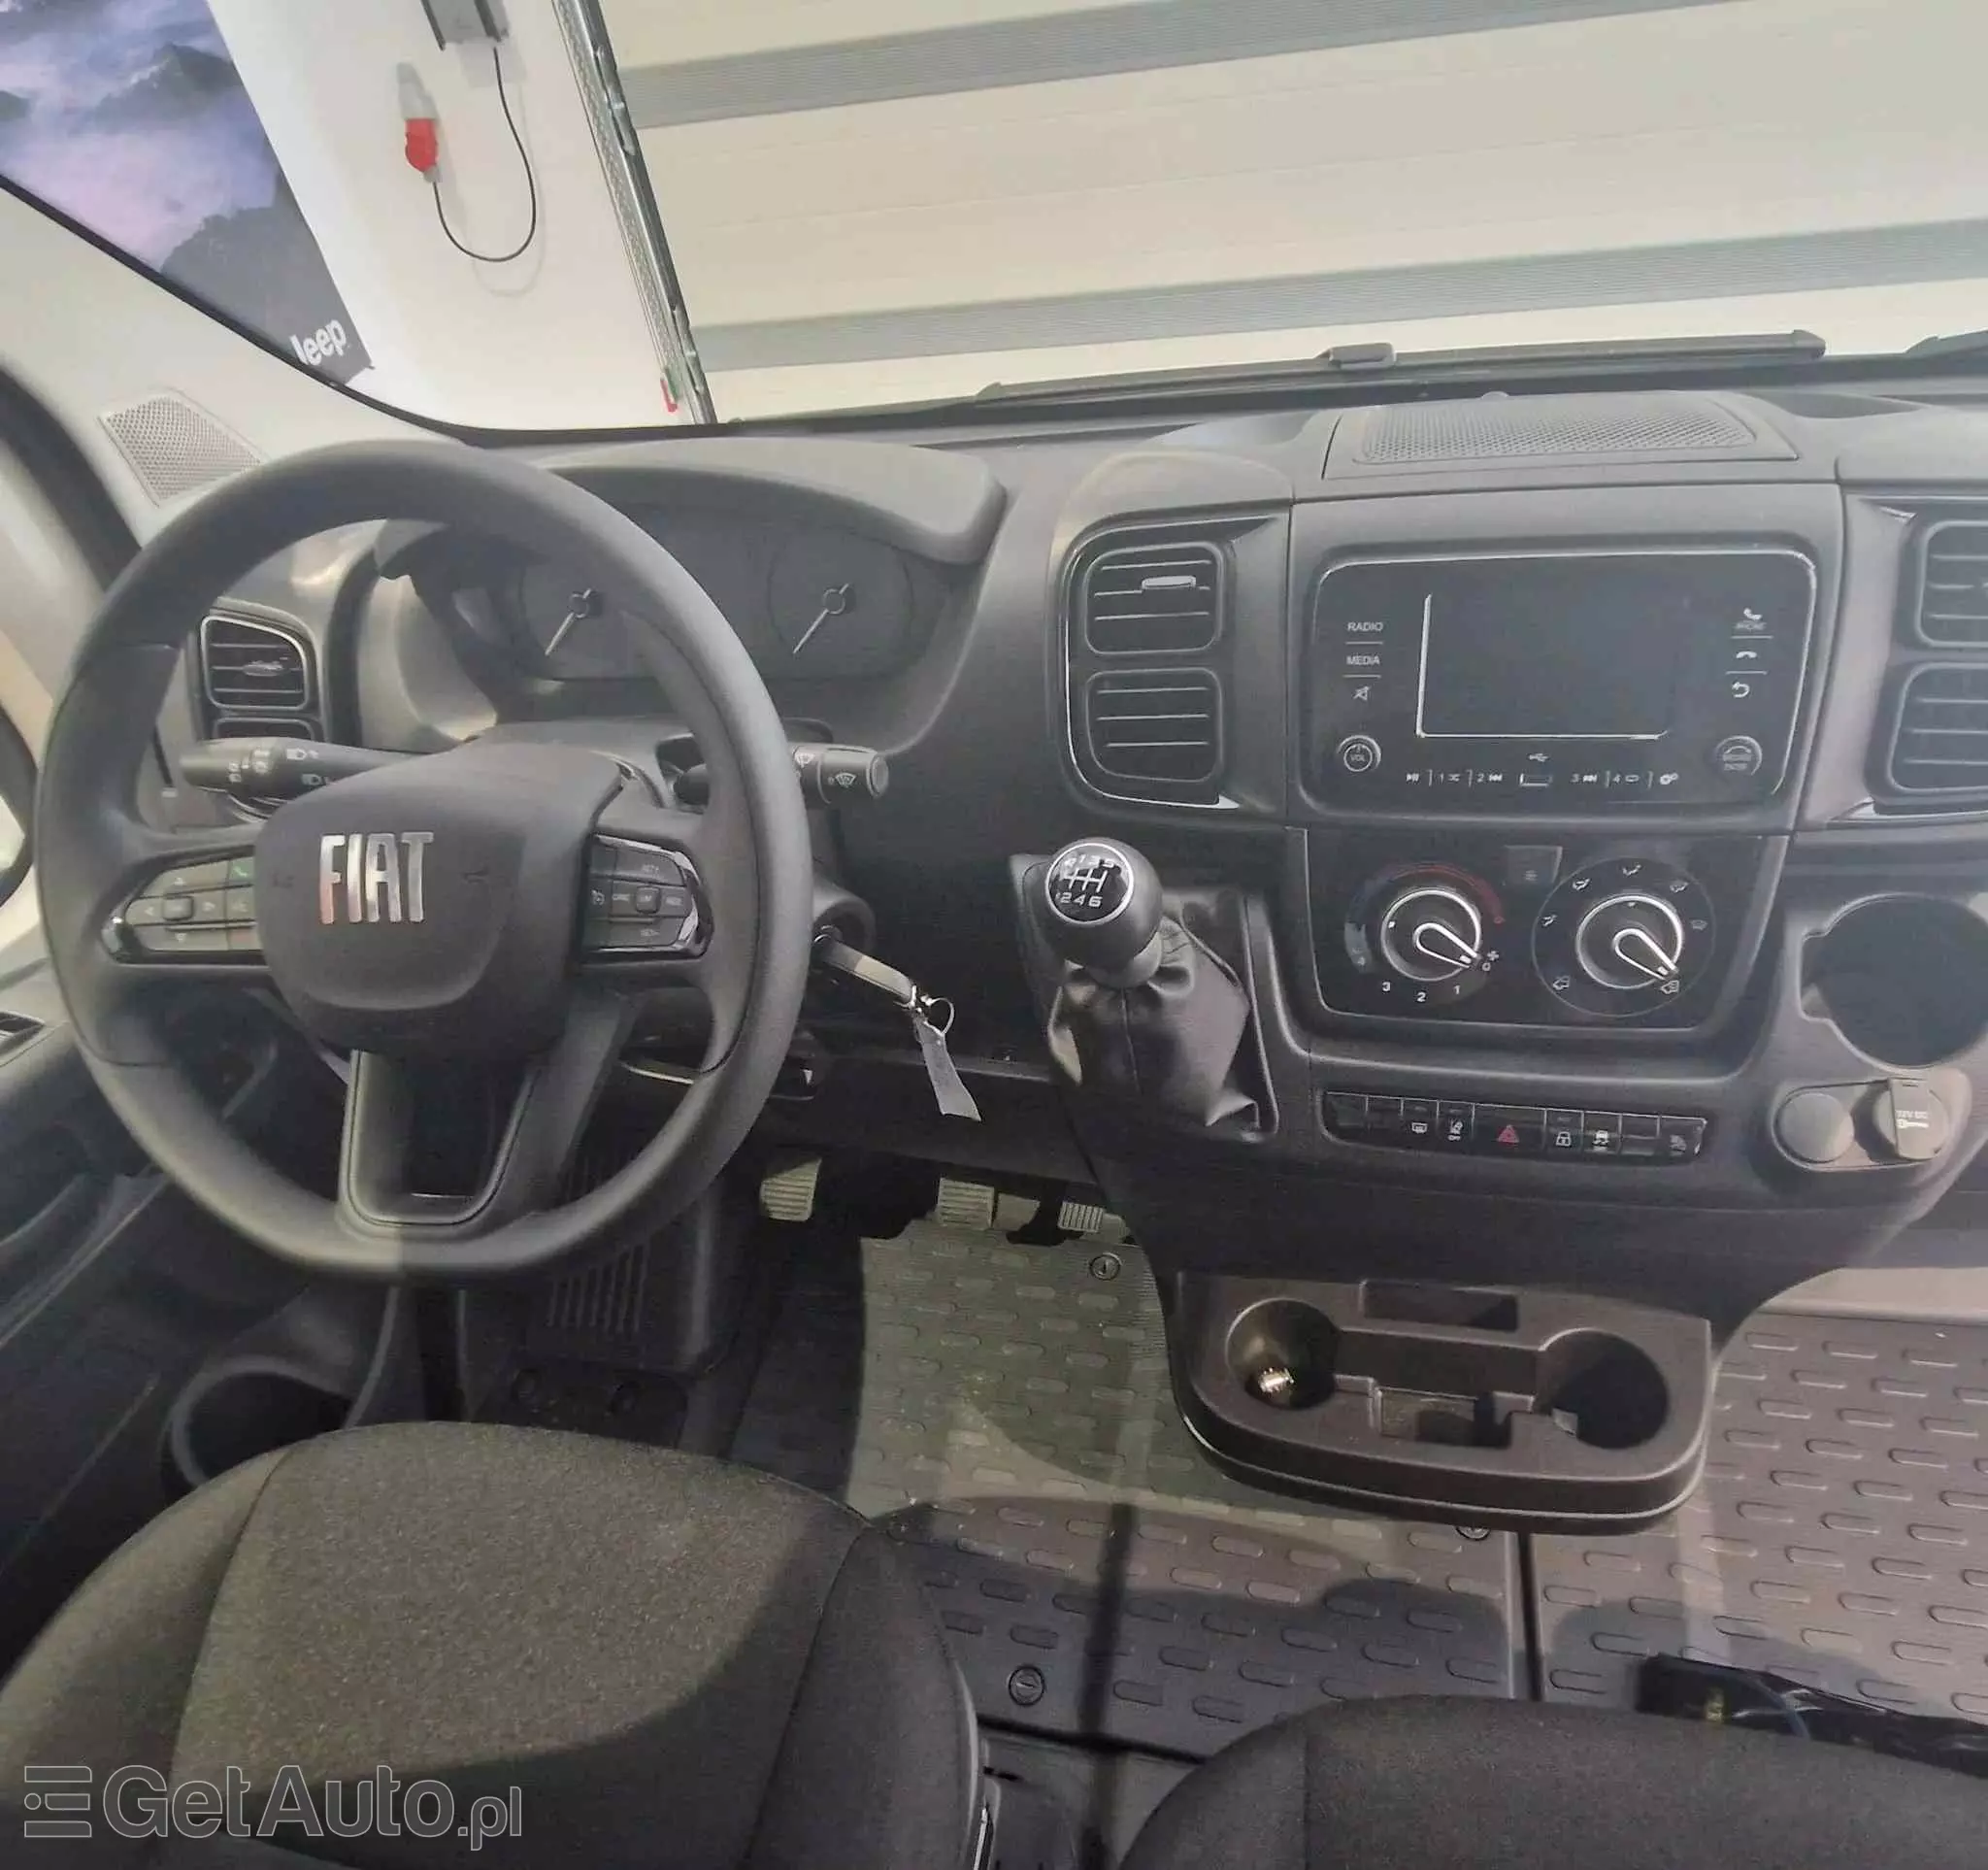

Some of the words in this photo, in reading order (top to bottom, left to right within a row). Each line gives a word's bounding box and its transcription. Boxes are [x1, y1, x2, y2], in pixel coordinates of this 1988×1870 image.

[1346, 621, 1384, 631] RADIO
[1346, 654, 1380, 665] MEDIA
[319, 831, 434, 924] FIAT
[1060, 891, 1073, 904] 2
[1074, 894, 1086, 906] 4
[1088, 896, 1103, 908] 6
[1381, 981, 1391, 992] 3
[1453, 985, 1461, 995] 1
[1416, 991, 1427, 1003] 2
